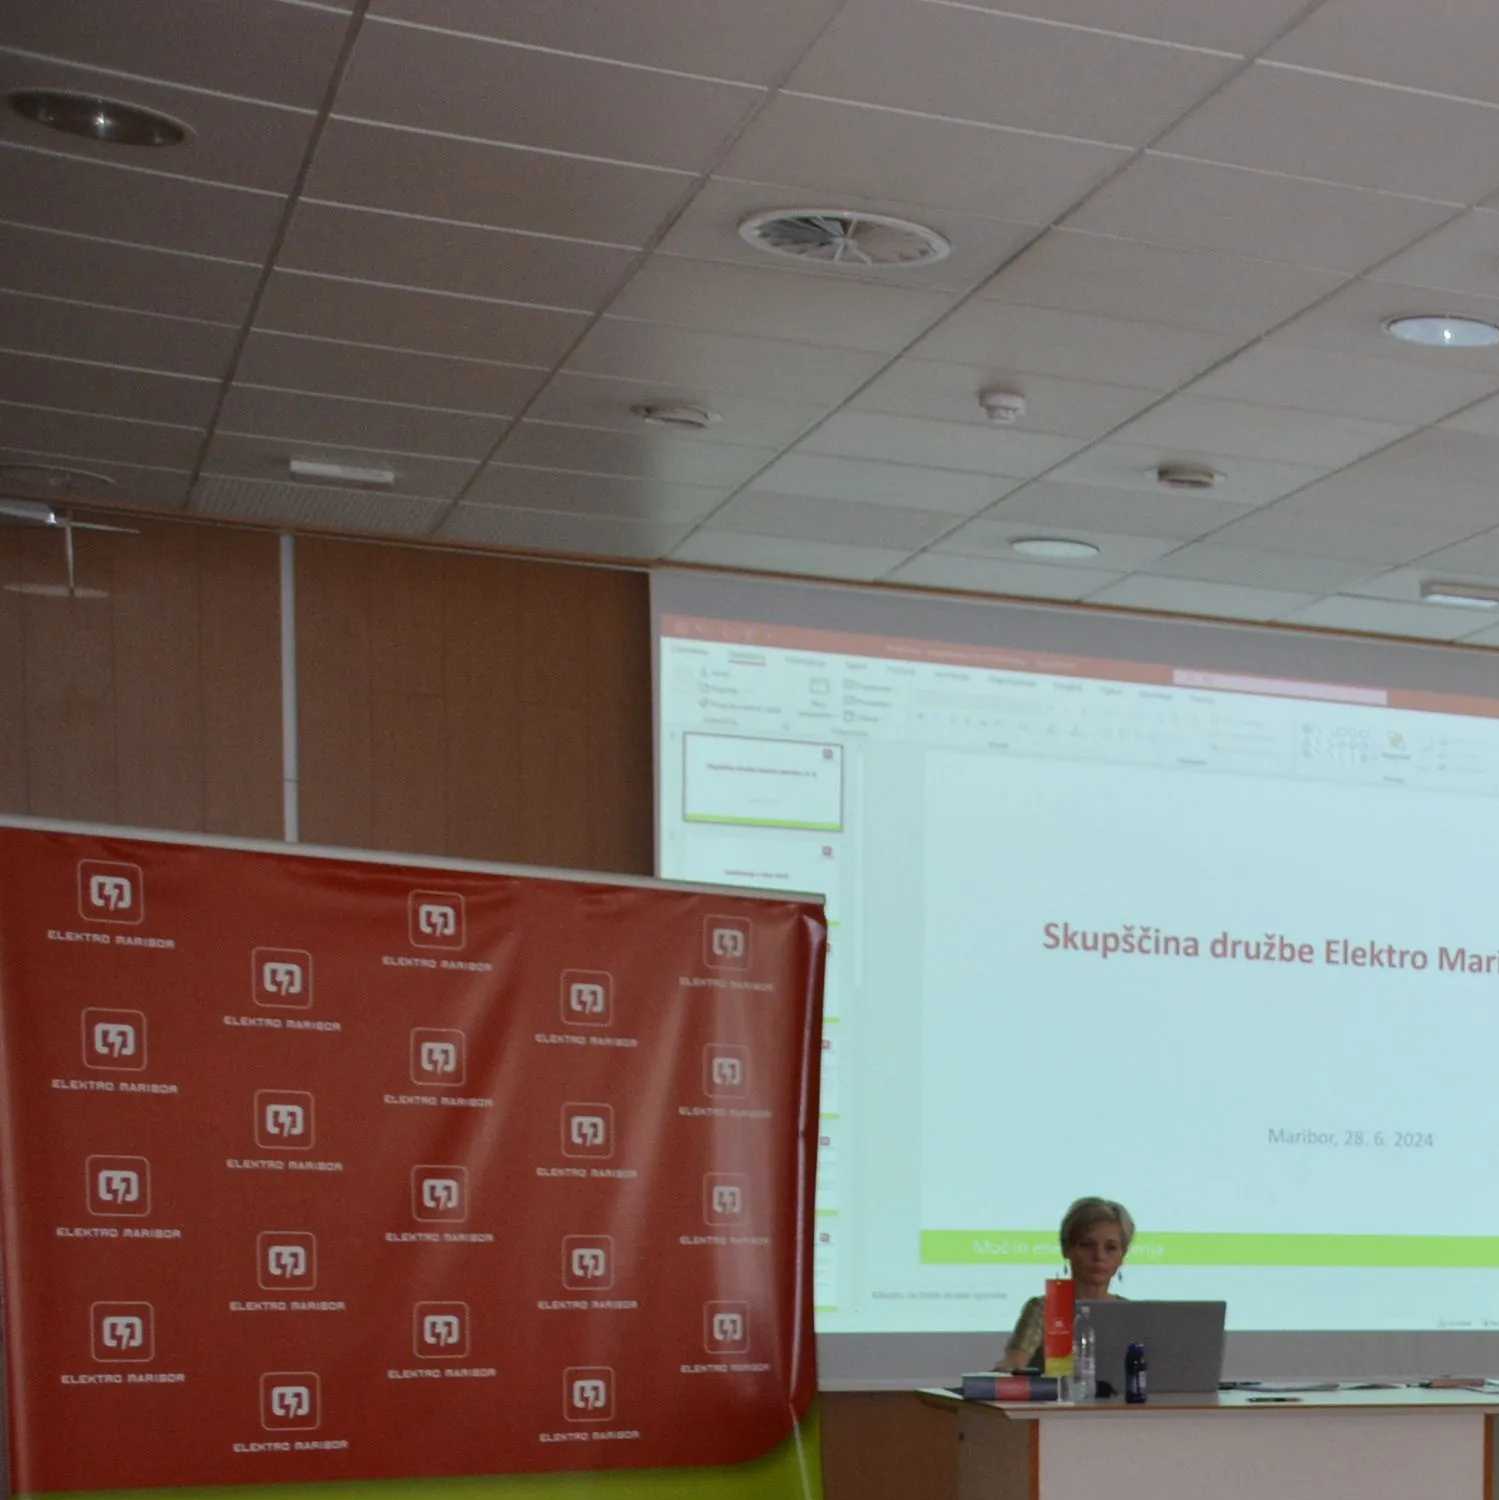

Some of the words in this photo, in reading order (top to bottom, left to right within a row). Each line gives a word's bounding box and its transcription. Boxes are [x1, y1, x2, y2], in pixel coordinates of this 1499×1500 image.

[48, 930, 110, 944] ELEKTRO
[116, 936, 175, 948] MARIBOR
[1043, 922, 1200, 959] Skupščina
[1210, 932, 1314, 964] družbe
[1324, 939, 1428, 970] Elektro
[382, 956, 436, 968] ELEKTRO
[441, 960, 492, 971] MARIBOR
[224, 1016, 282, 1028] ELEKTRO
[286, 1020, 341, 1031] MARIBOR
[535, 1034, 586, 1045] ELEKTRO
[52, 1079, 114, 1091] ELEKTRO
[119, 1083, 178, 1094] MARIBOR
[384, 1094, 437, 1105] ELEKTRO
[441, 1097, 492, 1107] MARIBOR
[1267, 1127, 1339, 1147] Maribor,
[1394, 1132, 1434, 1148] 2024
[227, 1159, 284, 1169] ELEKTRO
[288, 1161, 343, 1171] MARIBOR
[536, 1168, 587, 1177] ELEKTRO
[56, 1227, 118, 1237] ELEKTRO
[123, 1229, 181, 1238] MARIBOR
[385, 1233, 440, 1242] ELEKTRO
[444, 1234, 493, 1242] MARIBOR
[230, 1302, 287, 1311] ELEKTRO
[291, 1302, 345, 1310] MARIBOR
[538, 1301, 587, 1309] ELEKTRO
[61, 1374, 122, 1384] ELEKTRO
[127, 1373, 185, 1382] MARIBOR
[388, 1369, 441, 1379] ELEKTRO
[445, 1368, 496, 1377] MARIBOR
[539, 1432, 589, 1442] ELEKTRO
[233, 1442, 290, 1452] ELEKTRO
[294, 1440, 348, 1450] MARIBOR
